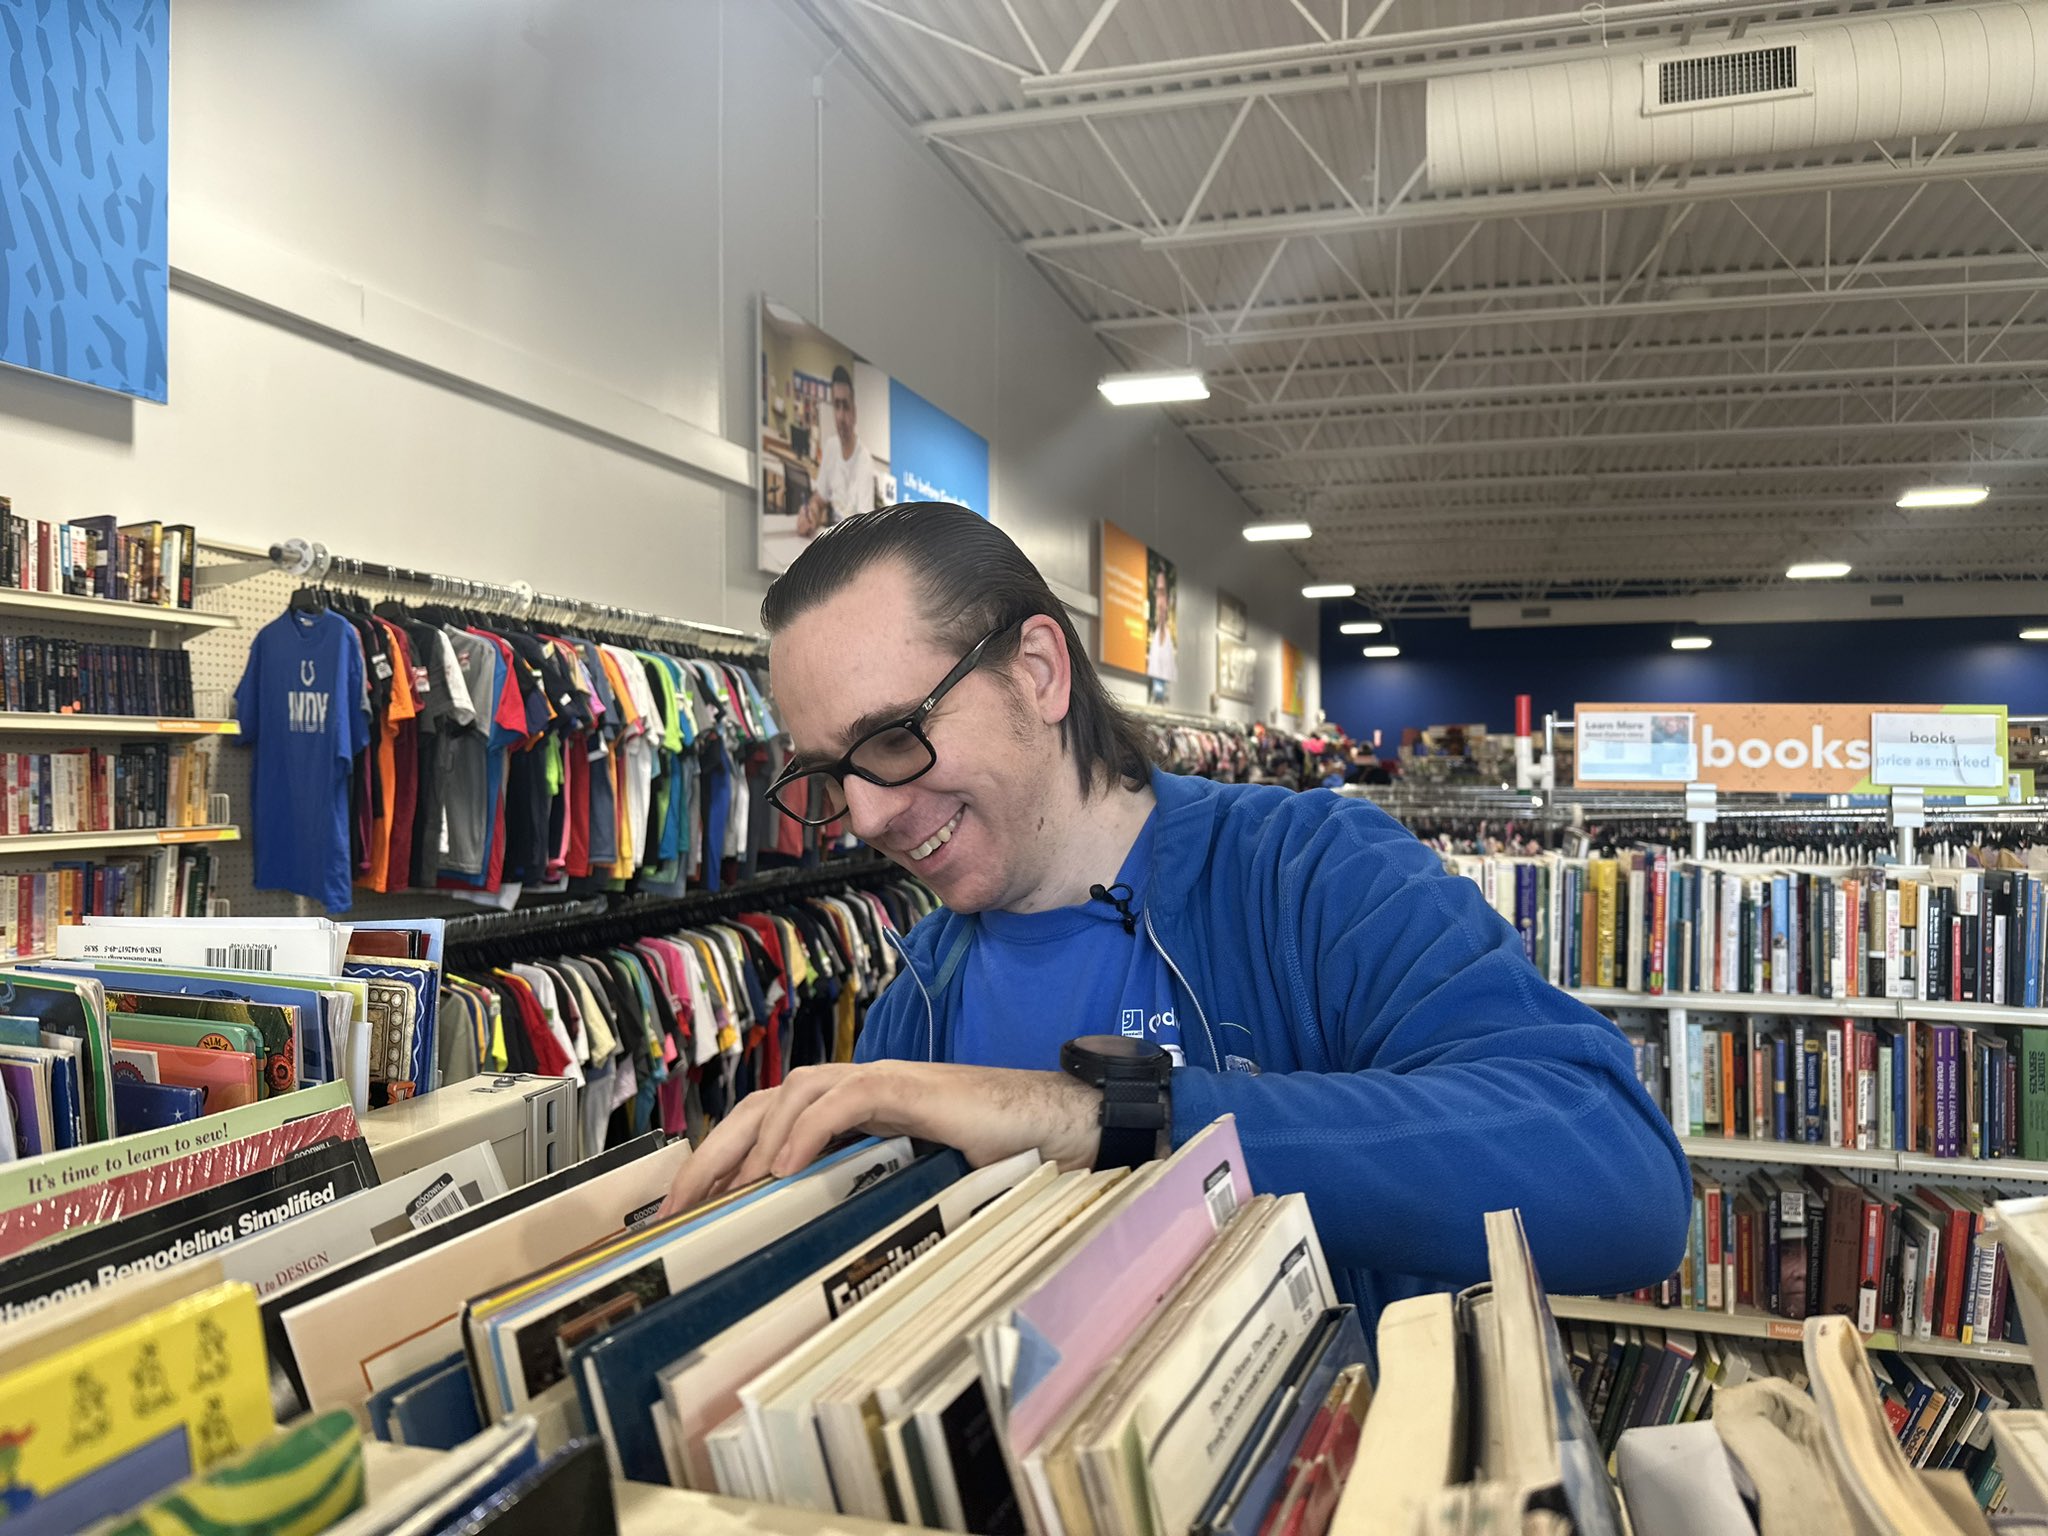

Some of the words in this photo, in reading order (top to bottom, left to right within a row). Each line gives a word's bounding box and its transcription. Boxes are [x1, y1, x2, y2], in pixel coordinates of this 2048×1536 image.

[288, 691, 329, 733] INDY
[1585, 720, 1614, 730] Learn
[1616, 720, 1644, 730] More
[1702, 723, 1870, 769] books
[1910, 731, 1956, 745] books
[1876, 755, 1913, 771] price
[1916, 757, 1931, 767] as
[1935, 755, 1990, 769] marked
[1985, 898, 1993, 941] RADICAL
[146, 946, 161, 954] ISBN
[1808, 1054, 1817, 1087] Western
[2029, 1051, 2037, 1095] SERVICES
[2037, 1051, 2046, 1092] STUDENT
[1807, 1088, 1817, 1110] Birds
[28, 1174, 57, 1195] It's
[60, 1164, 99, 1187] time
[106, 1155, 122, 1171] to
[127, 1144, 170, 1166] learn
[175, 1137, 191, 1152] to
[195, 1123, 229, 1146] sew!
[415, 1181, 447, 1209] GOODWILL
[633, 1202, 661, 1221] GOODWI
[0, 1278, 98, 1324] throom
[97, 1225, 235, 1288] Remodeling
[238, 1182, 335, 1237] Simplified
[1811, 1217, 1820, 1258] ARTIFICIAL
[265, 1280, 276, 1294] to
[275, 1251, 330, 1288] DESIGN
[1977, 1271, 1993, 1296] BIND
[1906, 1426, 1927, 1460] Socio
